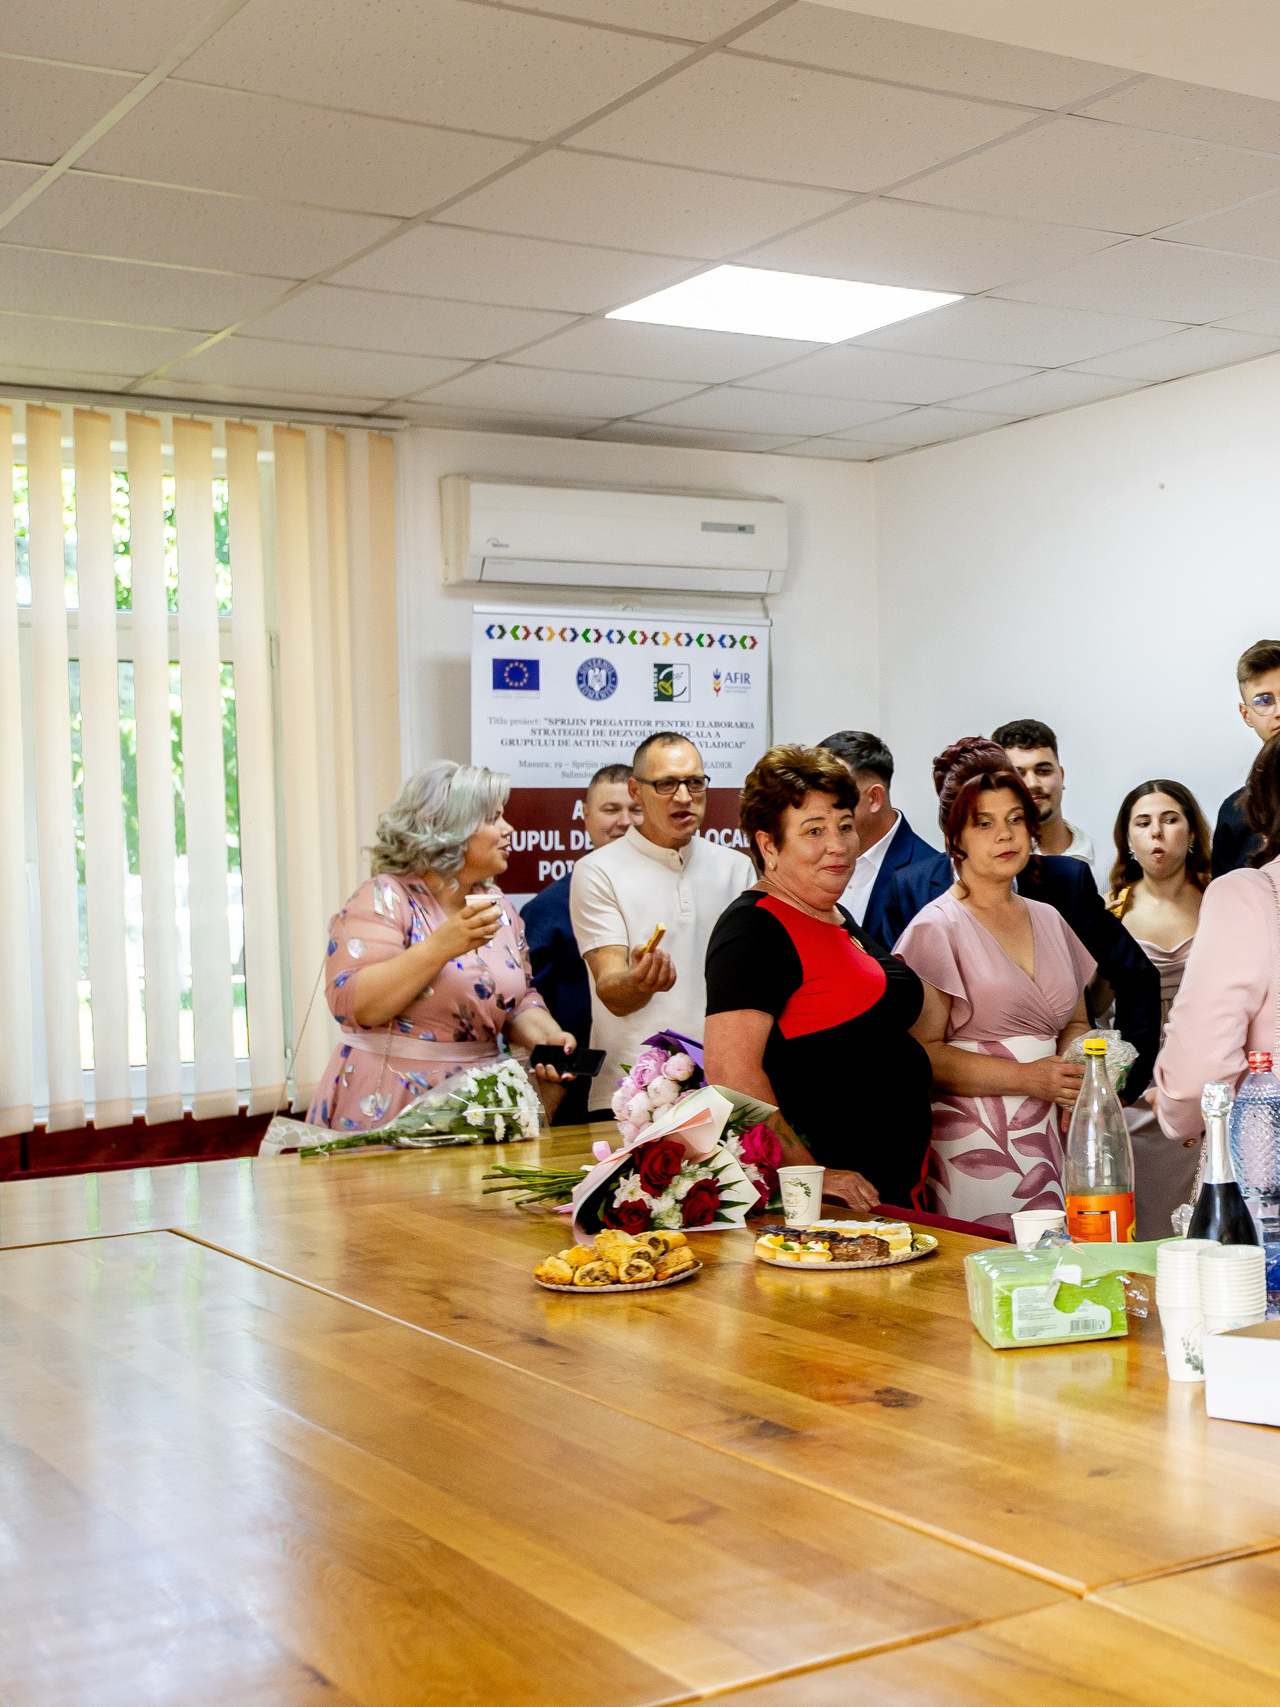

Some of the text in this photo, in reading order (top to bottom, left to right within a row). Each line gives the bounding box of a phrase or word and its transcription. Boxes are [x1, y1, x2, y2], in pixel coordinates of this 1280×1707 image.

[724, 672, 751, 685] AFIR
[589, 719, 652, 728] PREGATITOR
[655, 720, 694, 729] PENTRU
[696, 721, 755, 730] ELABORAREA
[530, 728, 590, 737] STRATEGIEI
[592, 729, 607, 738] DE
[679, 731, 713, 739] OCALA
[500, 738, 555, 747] GRUPULUI
[557, 739, 571, 748] DE
[573, 739, 617, 748] ACTIUNE
[703, 762, 733, 770] EADER
[506, 830, 566, 852] UPUL
[539, 860, 574, 882] POT
